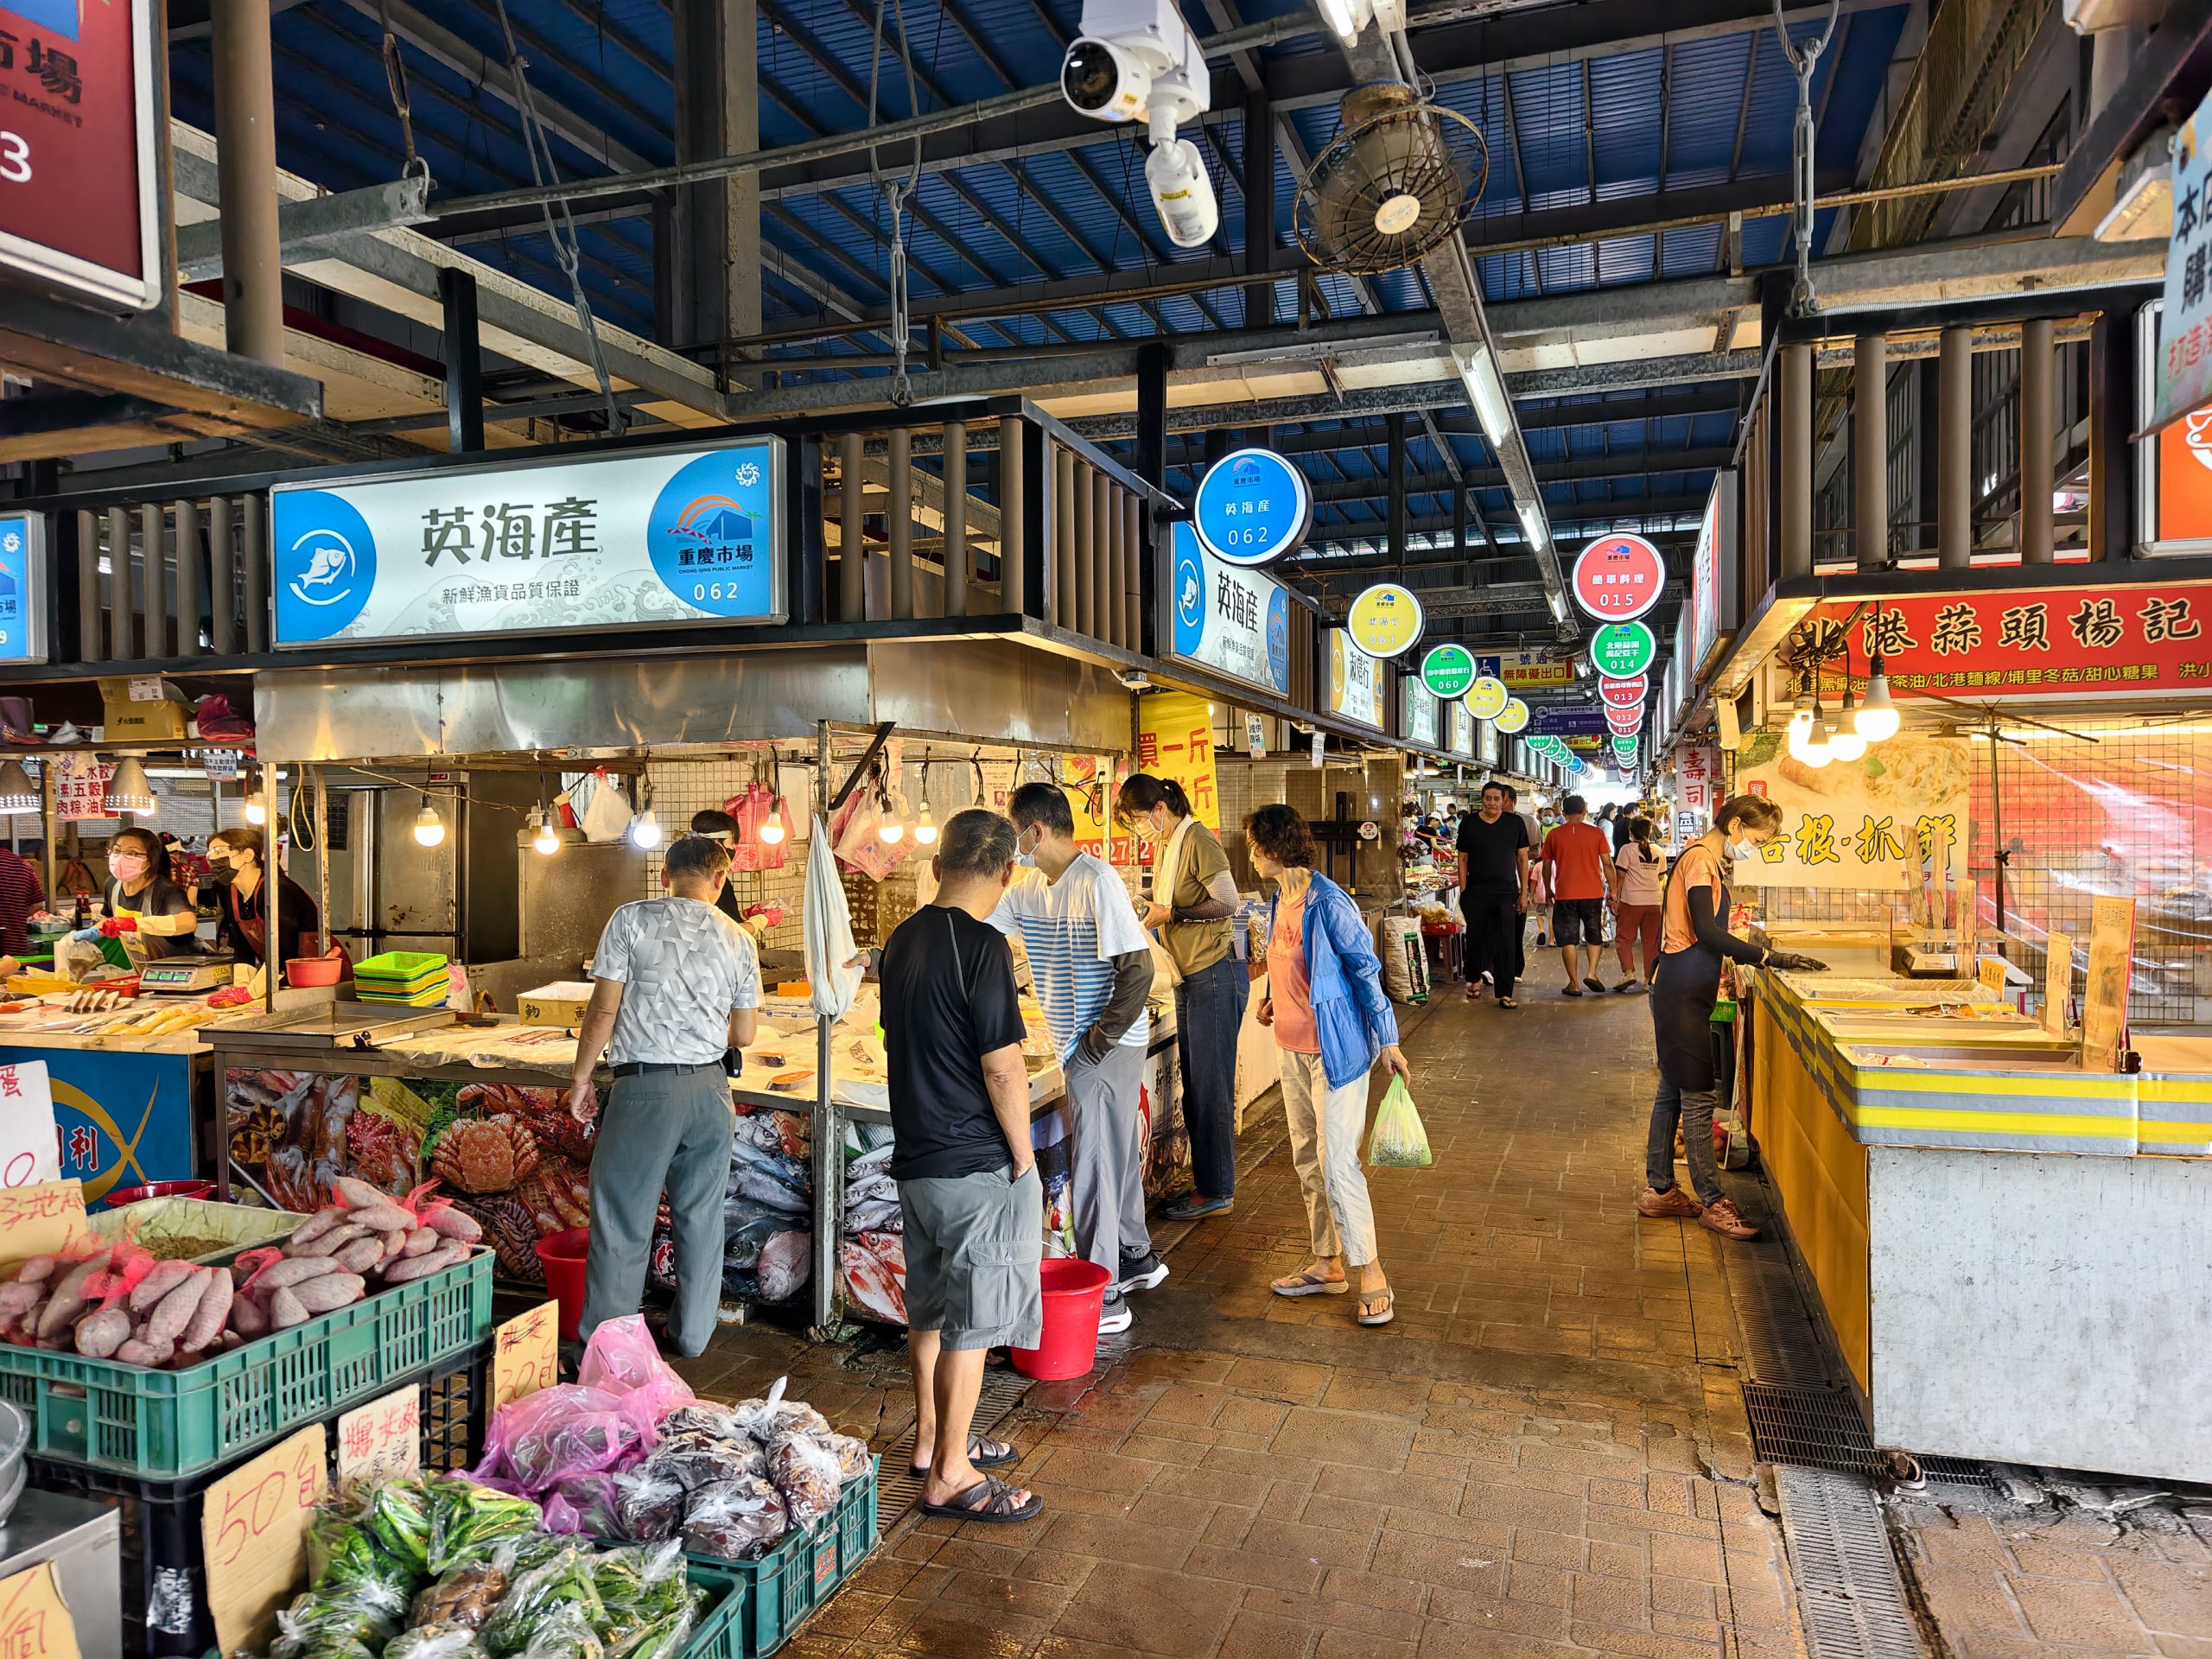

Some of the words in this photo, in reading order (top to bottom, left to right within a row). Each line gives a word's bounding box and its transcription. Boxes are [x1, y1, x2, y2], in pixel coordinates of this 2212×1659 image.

[422, 497, 598, 567] 英海產
[1228, 526, 1268, 545] 062
[678, 544, 753, 566] 重慶市場
[442, 580, 580, 605] 新鮮漁貨品質保證
[693, 582, 738, 601] 062
[1599, 594, 1634, 606] 015
[1807, 597, 2201, 658] 北港蒜頭楊記
[1369, 634, 1395, 645] 061
[1503, 667, 1565, 681] 無障礙出口
[1611, 660, 1635, 669] 014
[1438, 680, 1459, 690] 060
[1139, 727, 1209, 770] 買一斤
[1681, 748, 1707, 808] 壽司
[55, 1123, 99, 1172] 利
